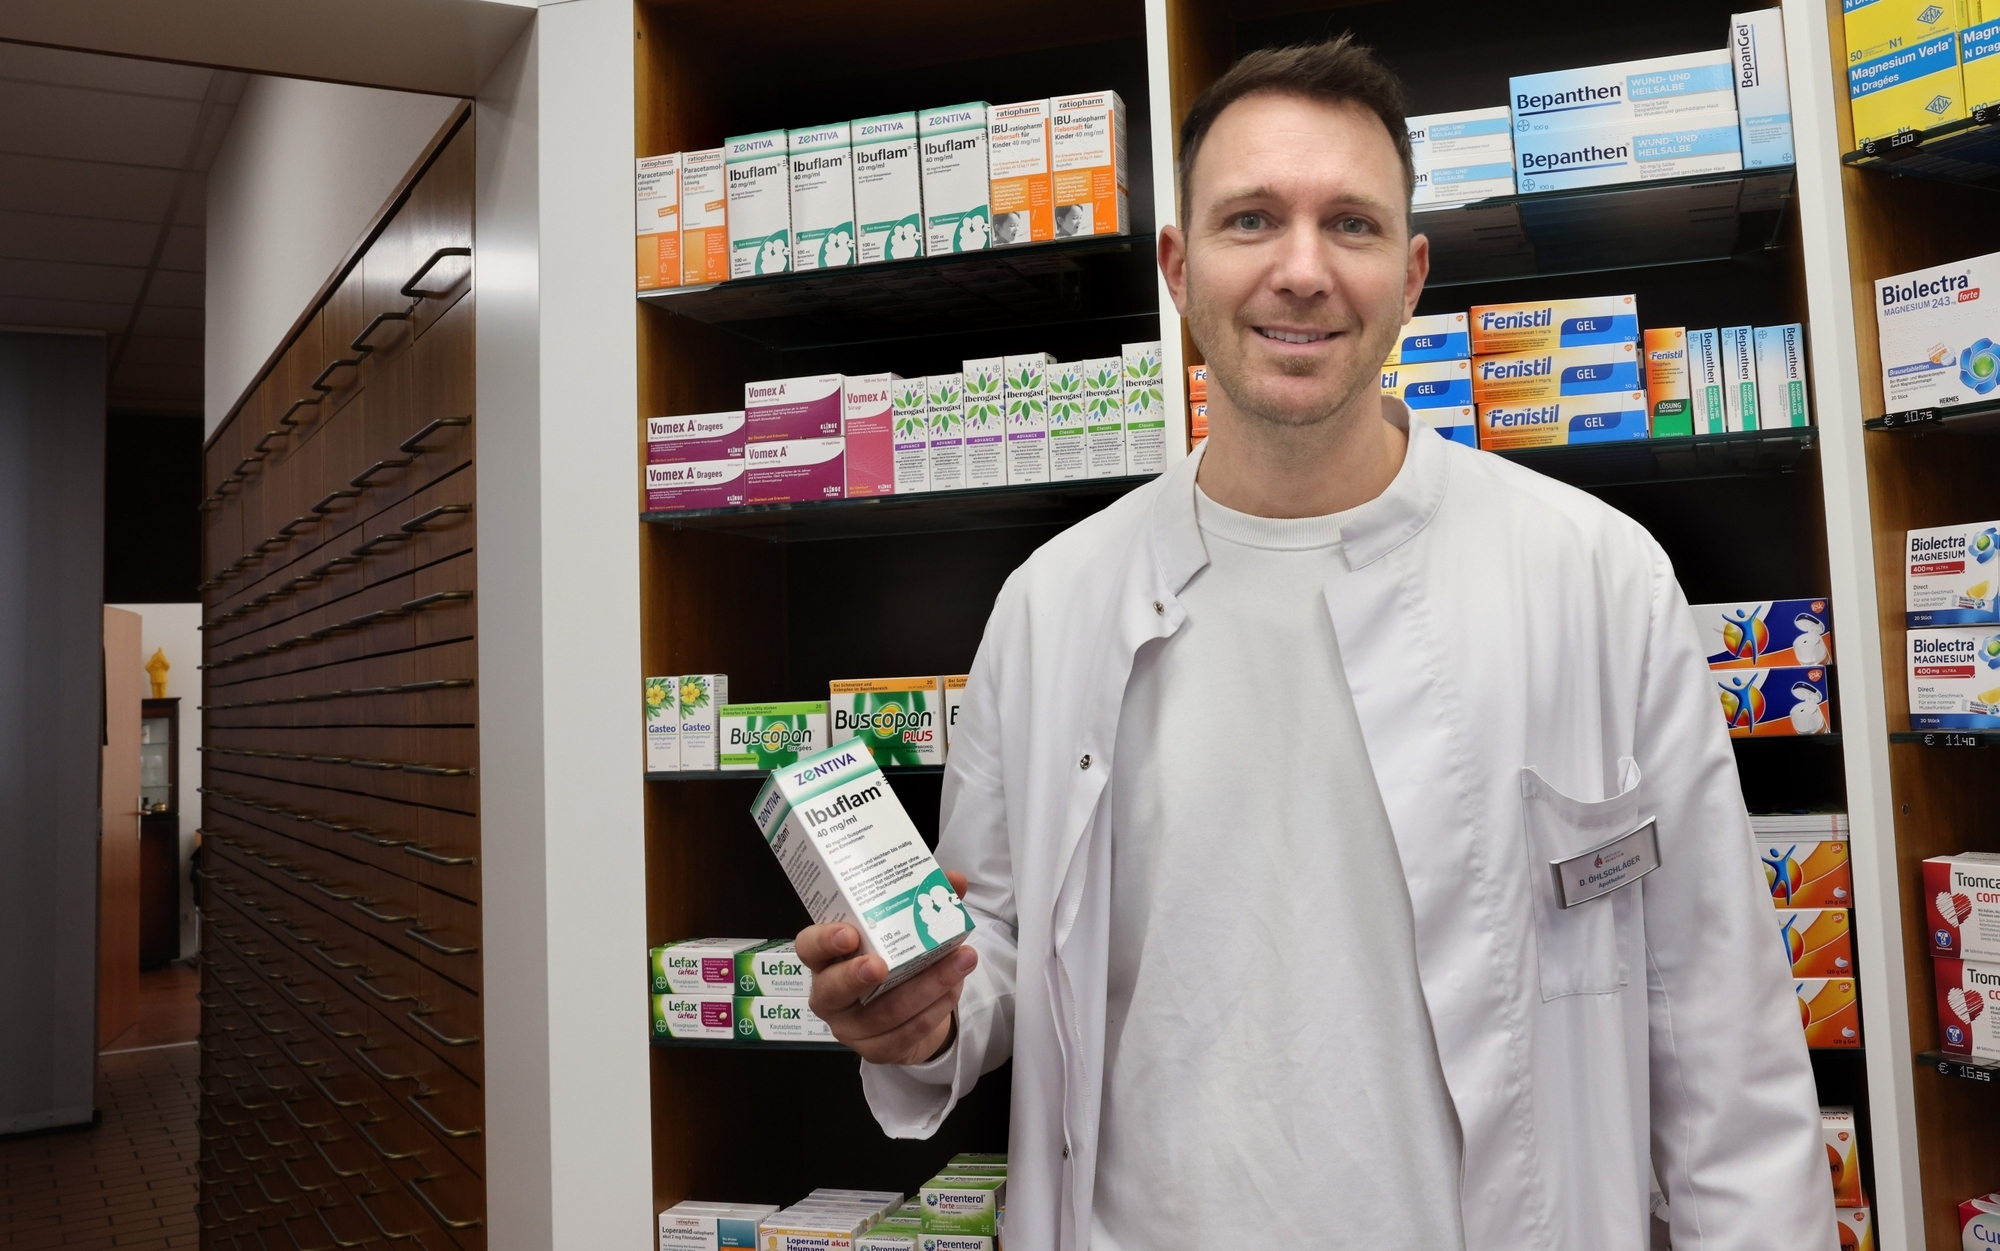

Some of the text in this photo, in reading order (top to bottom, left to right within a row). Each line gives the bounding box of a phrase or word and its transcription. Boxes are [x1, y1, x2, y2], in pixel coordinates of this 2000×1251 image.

[1849, 36, 1903, 62] 50 N1
[1964, 49, 1973, 59] N
[1738, 23, 1754, 88] BepanGel
[1851, 40, 1949, 81] Magnesium Verla
[1631, 72, 1691, 87] WUND- UND
[1852, 73, 1900, 95] N Dragées
[1631, 82, 1685, 96] HEILSALBE
[1059, 98, 1104, 109] ratiopharm
[1516, 84, 1622, 114] Bepanthen
[996, 106, 1040, 118] ratiopharm
[1054, 125, 1083, 133] Fiebersaft
[1054, 133, 1074, 141] Kinder
[1083, 129, 1104, 137] mg/ml
[1431, 130, 1462, 138] HEILSALBE
[991, 133, 1020, 142] Fiebersaft
[992, 141, 1011, 149] Kinder
[1020, 138, 1041, 146] mg/ml
[1637, 134, 1698, 148] WUND- UND
[1638, 144, 1692, 157] HEILSALBE
[1865, 142, 1876, 154] €
[641, 159, 673, 168] ratiopharm
[687, 153, 720, 162] ratiopharm
[925, 153, 954, 164] 40 mg/ml
[1521, 144, 1628, 174] Bepanthen
[684, 164, 723, 174] Paracetamol-
[857, 162, 885, 173] 40 mg/ml
[637, 170, 676, 180] Paracetamol-
[793, 171, 821, 181] 40 mg/ml
[730, 179, 757, 190] 40 mg/ml
[1958, 290, 1979, 302] forte
[1883, 300, 1931, 317] MAGNESIUM
[1931, 296, 1951, 310] 243
[1483, 307, 1552, 331] Fenistil
[1576, 320, 1597, 332] GEL
[1415, 338, 1433, 348] GEL
[1650, 350, 1683, 360] Fenistil
[1703, 332, 1716, 384] Bepanthen
[1738, 328, 1751, 380] Bepanthen
[1786, 327, 1798, 379] Bepanthen
[1483, 356, 1552, 381] Fenistil
[1576, 368, 1597, 380] GEL
[1889, 363, 1930, 376] Brausetabletten
[1125, 377, 1164, 389] Iberogast
[748, 384, 786, 398] Vomex A
[1006, 389, 1044, 401] Iberogast
[1086, 387, 1120, 399] Iberogast
[1418, 384, 1436, 395] GEL
[847, 390, 888, 404] Vomex A
[964, 393, 1001, 405] Iberogast
[1049, 391, 1083, 403] Iberogast
[1939, 395, 1960, 405] HERMES
[929, 403, 962, 414] Iberogast
[1658, 401, 1682, 410] LÖSUNG
[893, 407, 925, 417] Iberogast
[1490, 404, 1560, 428] Fenistil
[1584, 417, 1605, 428] GEL
[1884, 414, 1894, 426] €
[650, 419, 724, 435] Vomex A Dragees
[748, 446, 787, 460] Vomex A
[649, 467, 723, 482] Vomex A Dragees
[1911, 535, 1966, 552] Biolectra
[1911, 550, 1966, 562] MAGNESIUM
[1913, 638, 1975, 654] Biolectra
[1913, 654, 1975, 664] MAGNESIUM
[682, 722, 711, 732] Gasteo
[835, 709, 932, 734] Buscopan
[648, 723, 677, 734] Gasteo
[730, 728, 812, 749] Buscopan
[903, 730, 933, 743] PLUS
[1924, 734, 1935, 747] €
[816, 814, 858, 839] 40 mg/ml
[847, 824, 874, 839] Suspension
[839, 834, 865, 850] Einnehmen
[1831, 844, 1842, 853] gsk
[1598, 873, 1627, 889] Apotheker
[879, 929, 902, 943] 100 ml
[883, 932, 912, 949] Suspension
[890, 944, 917, 961] Einnehmen
[668, 957, 698, 969] Lefax
[761, 960, 803, 976] Lefax
[677, 967, 698, 977] intens
[771, 979, 804, 987] Kautabletten
[668, 1001, 697, 1012] Lefax
[760, 1004, 801, 1020] Lefax
[677, 1011, 698, 1020] intens
[769, 1023, 802, 1031] Kautabletten
[1937, 1062, 1949, 1075] €
[939, 1193, 984, 1203] Perenterol
[939, 1202, 955, 1210] forte
[786, 1237, 850, 1248] Loperamid akut
[936, 1239, 981, 1249] Perenterol
